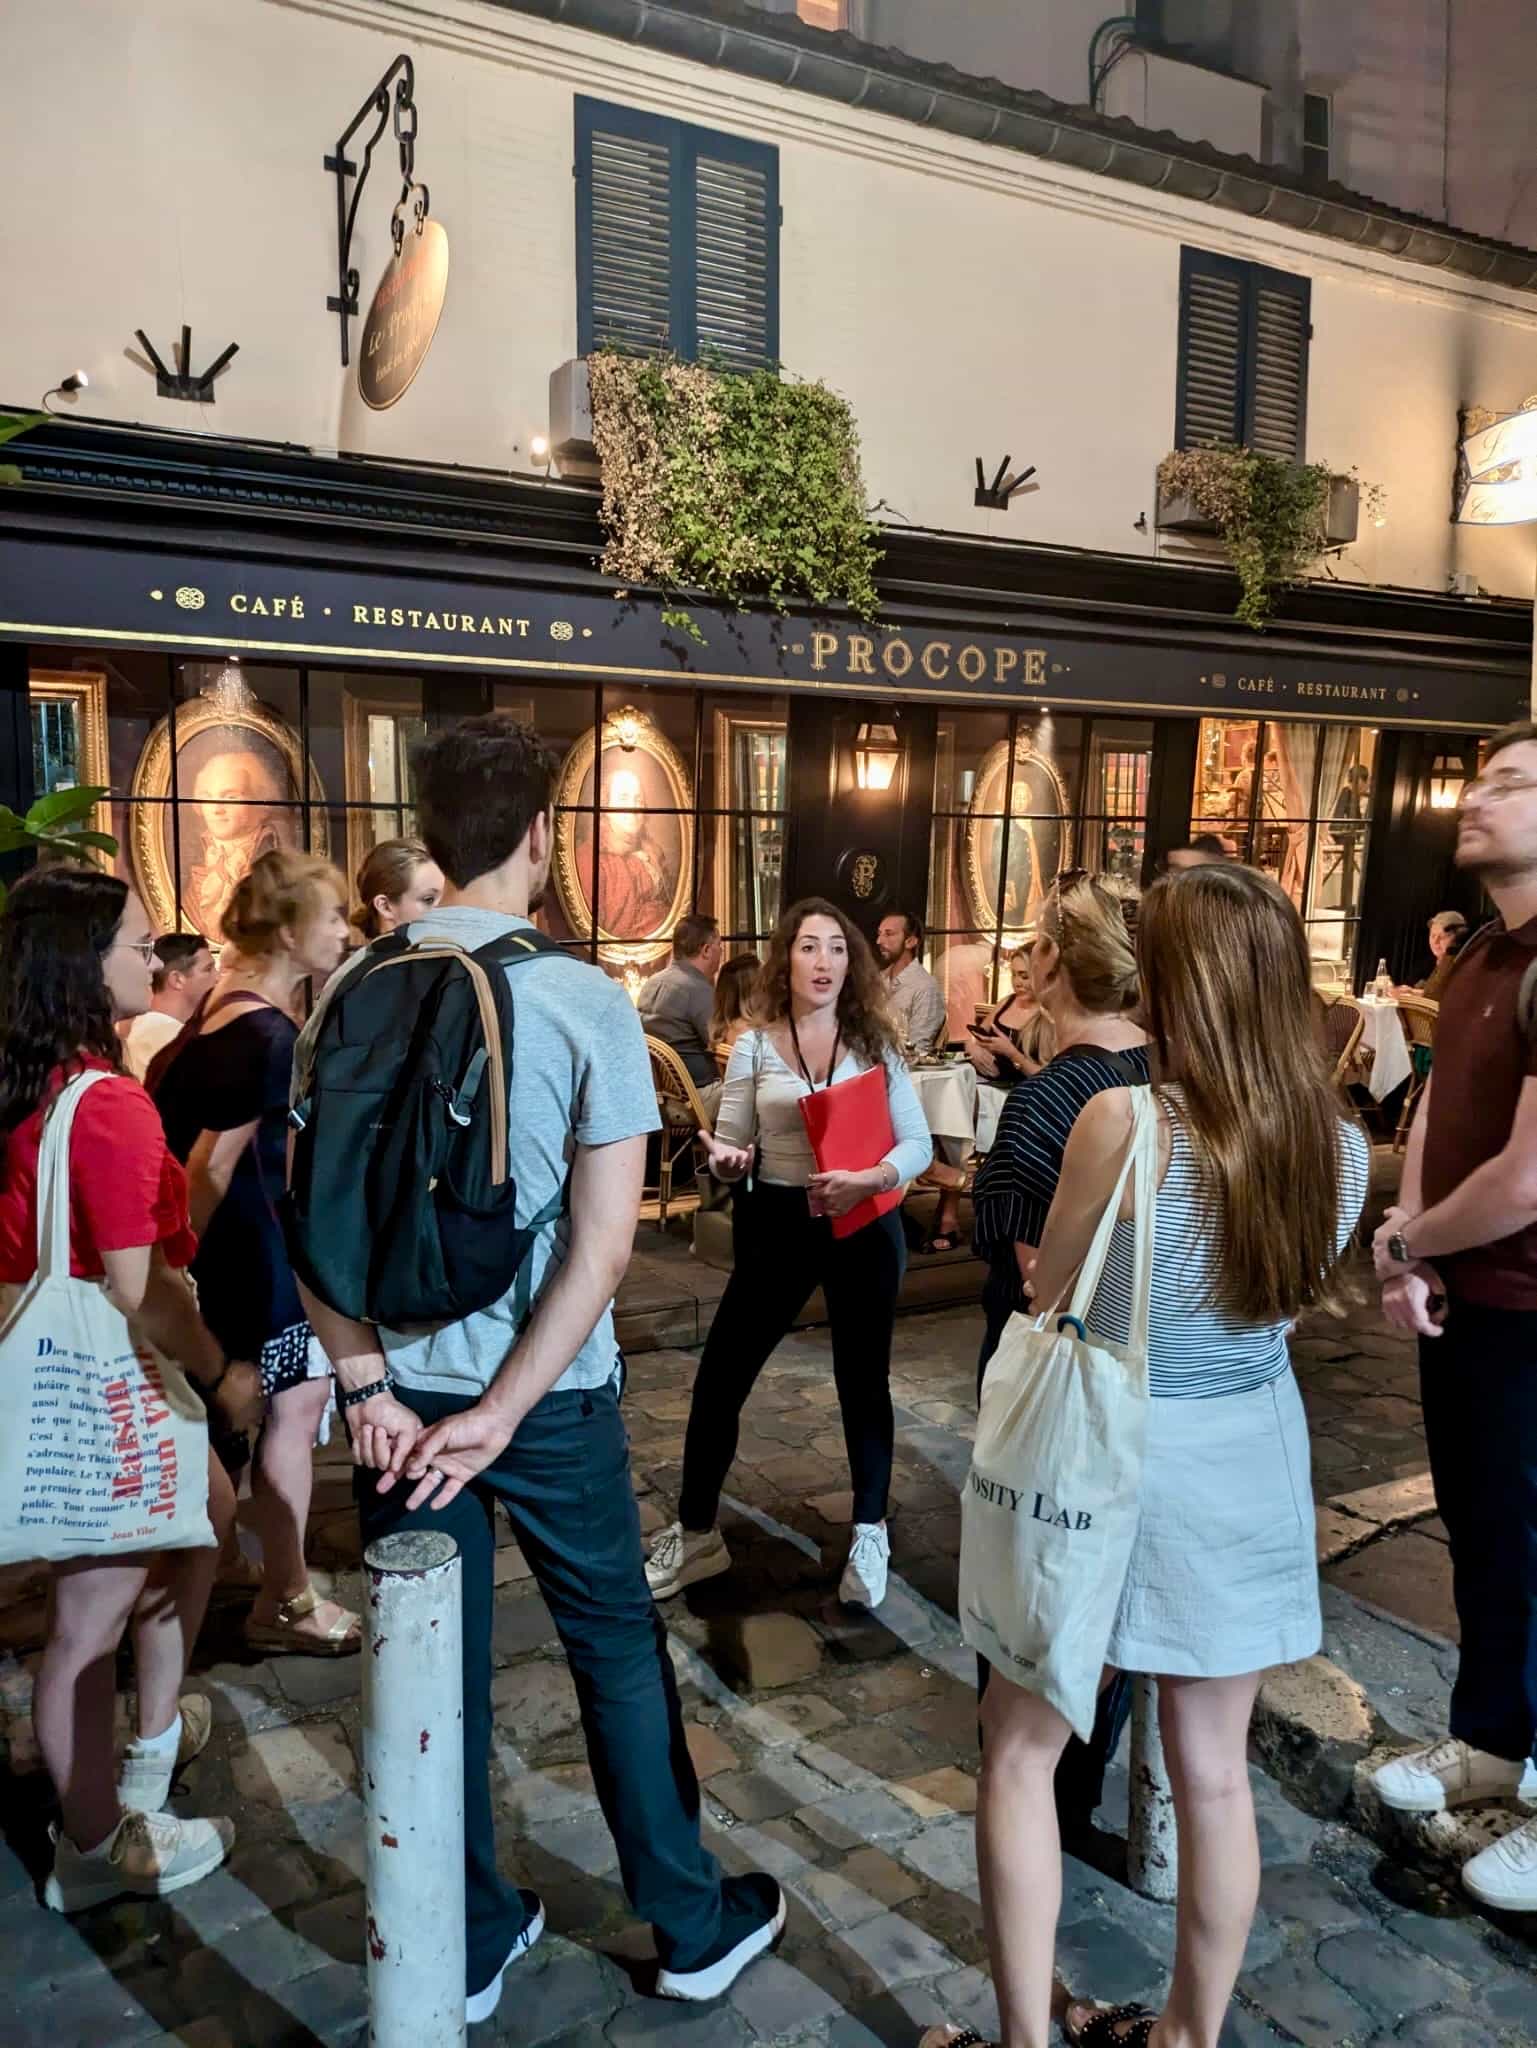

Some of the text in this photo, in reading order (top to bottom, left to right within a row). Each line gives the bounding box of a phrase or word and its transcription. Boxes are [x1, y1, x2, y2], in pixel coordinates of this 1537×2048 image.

[230, 594, 531, 638] CAFÉ RESTAURANT
[810, 631, 1048, 686] PROCOPE
[1237, 675, 1387, 701] CAFÉ RESTAURANT
[73, 1351, 97, 1363] merc
[34, 1365, 82, 1378] certaines
[33, 1380, 71, 1393] théâtre
[32, 1398, 59, 1409] aussi
[31, 1416, 47, 1426] vie
[52, 1416, 72, 1428] que
[78, 1418, 87, 1428] le
[29, 1432, 53, 1443] C'est
[78, 1437, 96, 1446] eux
[27, 1448, 75, 1461] s'adresse
[76, 1451, 87, 1462] le
[80, 1469, 93, 1480] Le
[148, 1436, 178, 1520] Jean
[24, 1486, 36, 1495] au
[40, 1483, 82, 1497] premier
[971, 1470, 1025, 1512] OSITY
[63, 1502, 85, 1513] Tout
[89, 1502, 125, 1514] comme
[130, 1499, 139, 1509] le
[112, 1526, 158, 1541] Jean Vilar
